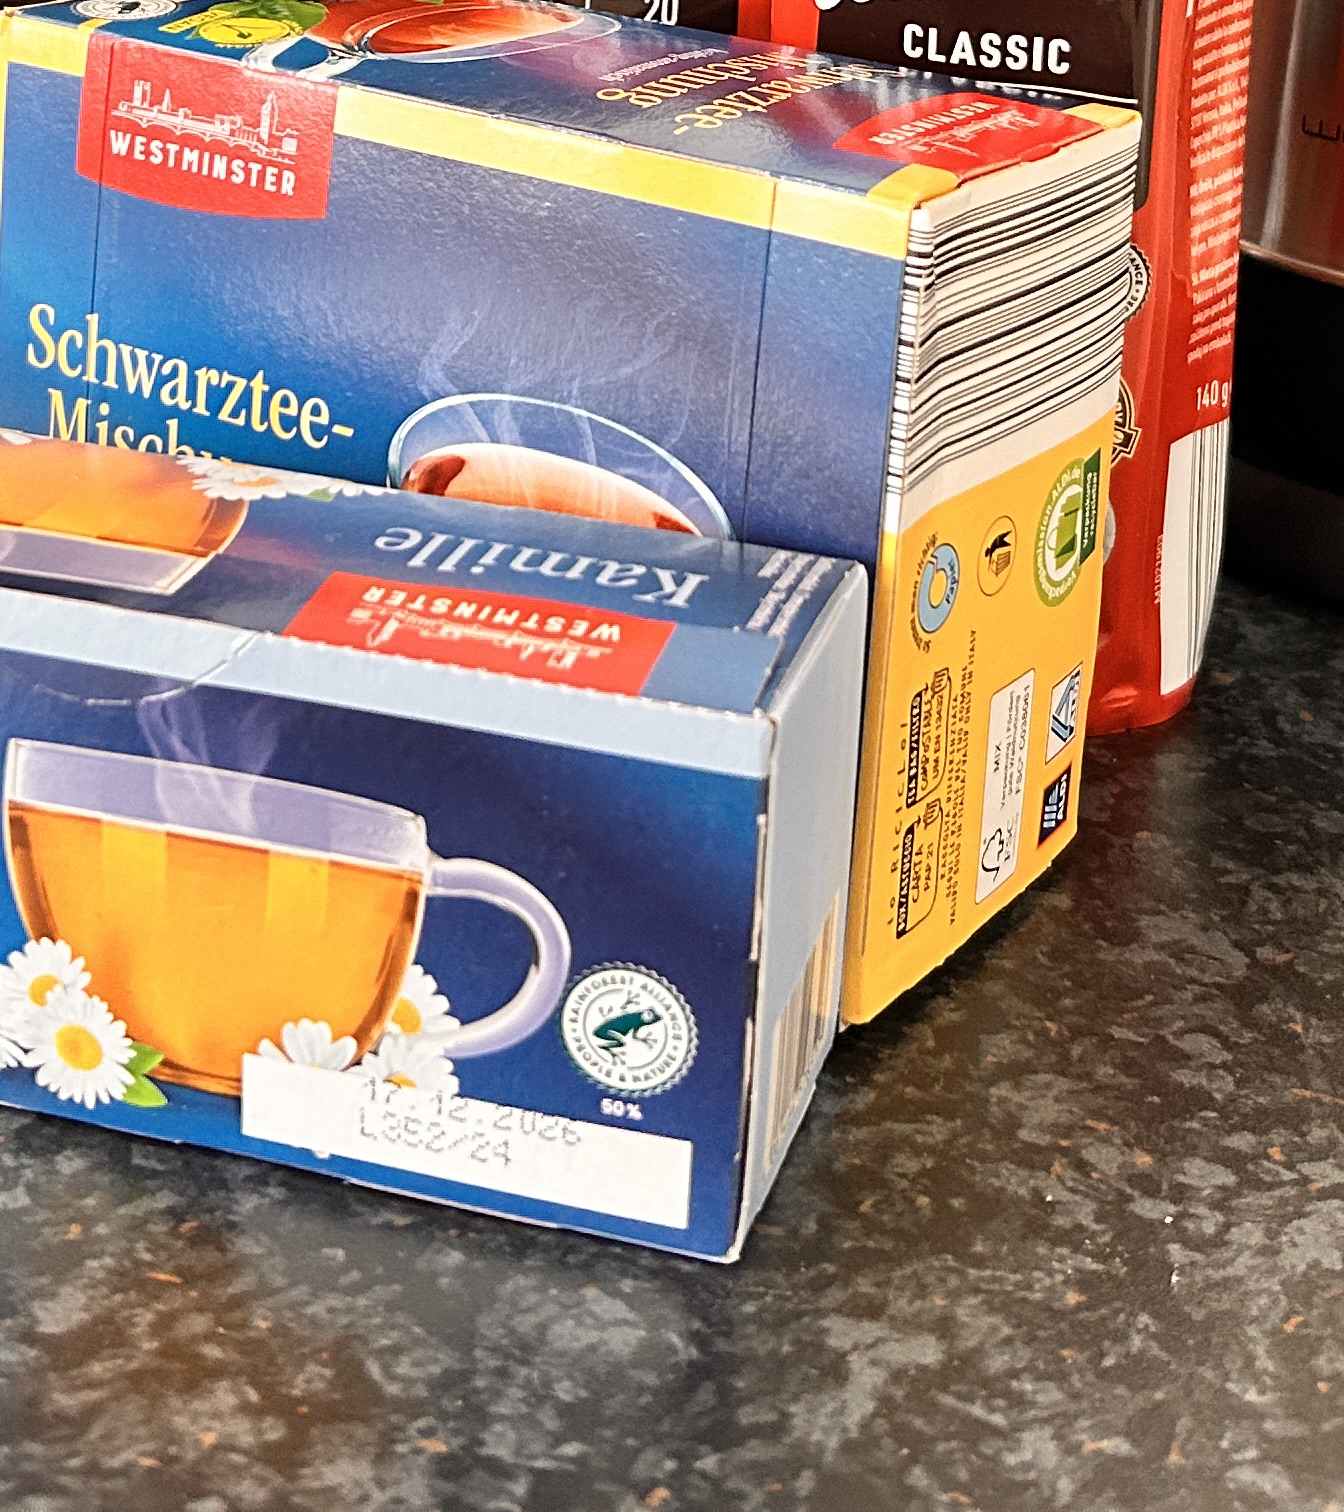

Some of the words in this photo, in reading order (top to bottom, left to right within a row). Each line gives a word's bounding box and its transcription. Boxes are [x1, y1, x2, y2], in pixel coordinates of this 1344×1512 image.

[903, 23, 1071, 75] CLASSIC
[868, 101, 1000, 145] WESTMINSTER
[109, 130, 296, 197] WESTMINSTER
[26, 303, 355, 450] Schwarztee-
[1196, 380, 1218, 411] 140
[373, 525, 710, 608] Kamille
[362, 585, 622, 642] WESTMINSTER
[992, 740, 1001, 774] MIX
[1057, 772, 1067, 822] ALDI
[910, 842, 923, 906] CARTA
[923, 859, 932, 893] PAP
[925, 840, 934, 861] 21
